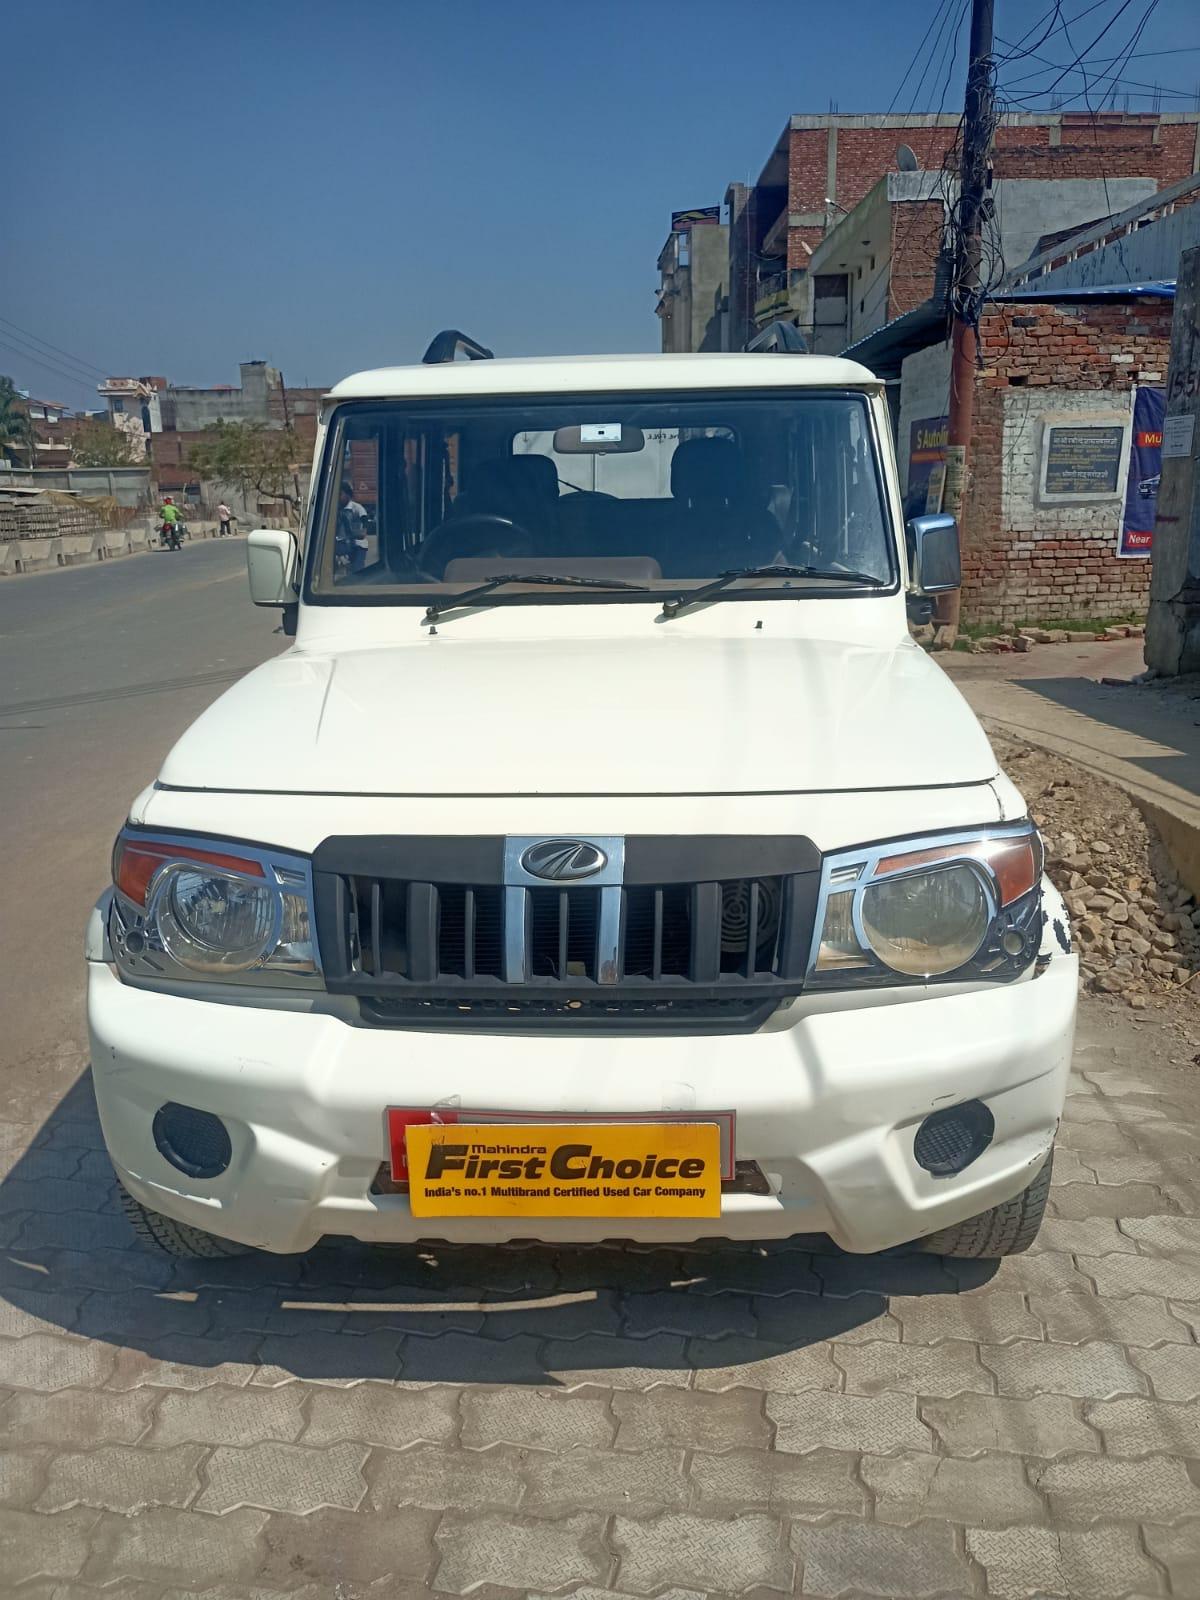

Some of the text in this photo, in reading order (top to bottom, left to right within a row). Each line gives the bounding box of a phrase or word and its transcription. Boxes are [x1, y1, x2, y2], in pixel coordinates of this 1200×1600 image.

[1128, 533, 1151, 545] Near
[471, 1144, 547, 1154] Mahindra
[424, 1144, 547, 1180] First
[550, 1144, 705, 1179] Choice
[424, 1186, 706, 1199] India's no.1 Multibrand Certified Used Car Company
